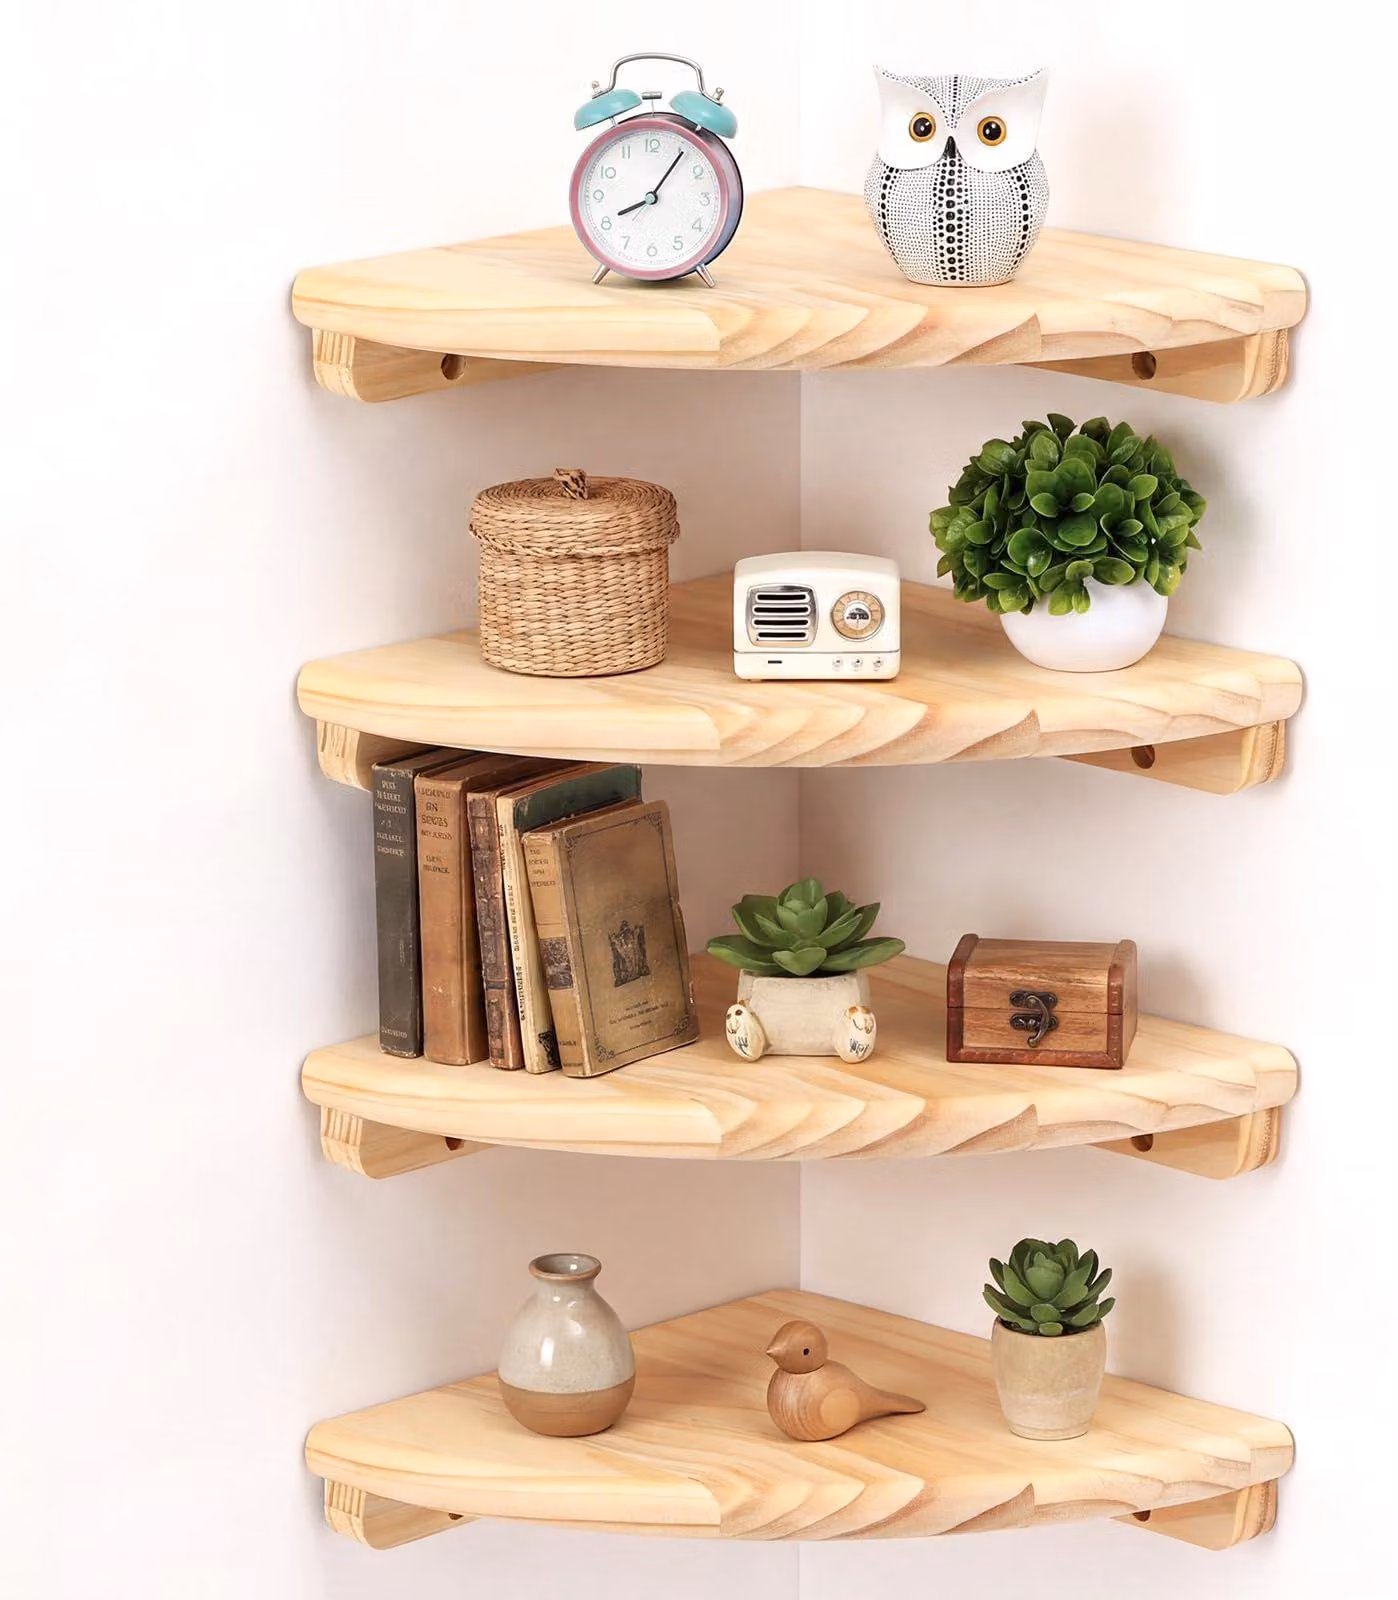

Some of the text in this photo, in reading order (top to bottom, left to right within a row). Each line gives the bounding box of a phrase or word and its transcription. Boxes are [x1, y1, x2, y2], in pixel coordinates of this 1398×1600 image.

[622, 145, 631, 159] 11
[645, 138, 660, 153] 12
[600, 165, 617, 179] 10
[693, 165, 704, 180] 2
[592, 189, 604, 203] 9
[700, 192, 711, 207] 3
[600, 216, 612, 231] 8
[692, 218, 703, 232] 4
[621, 236, 630, 250] 7
[646, 243, 658, 257] 6
[673, 236, 684, 251] 5
